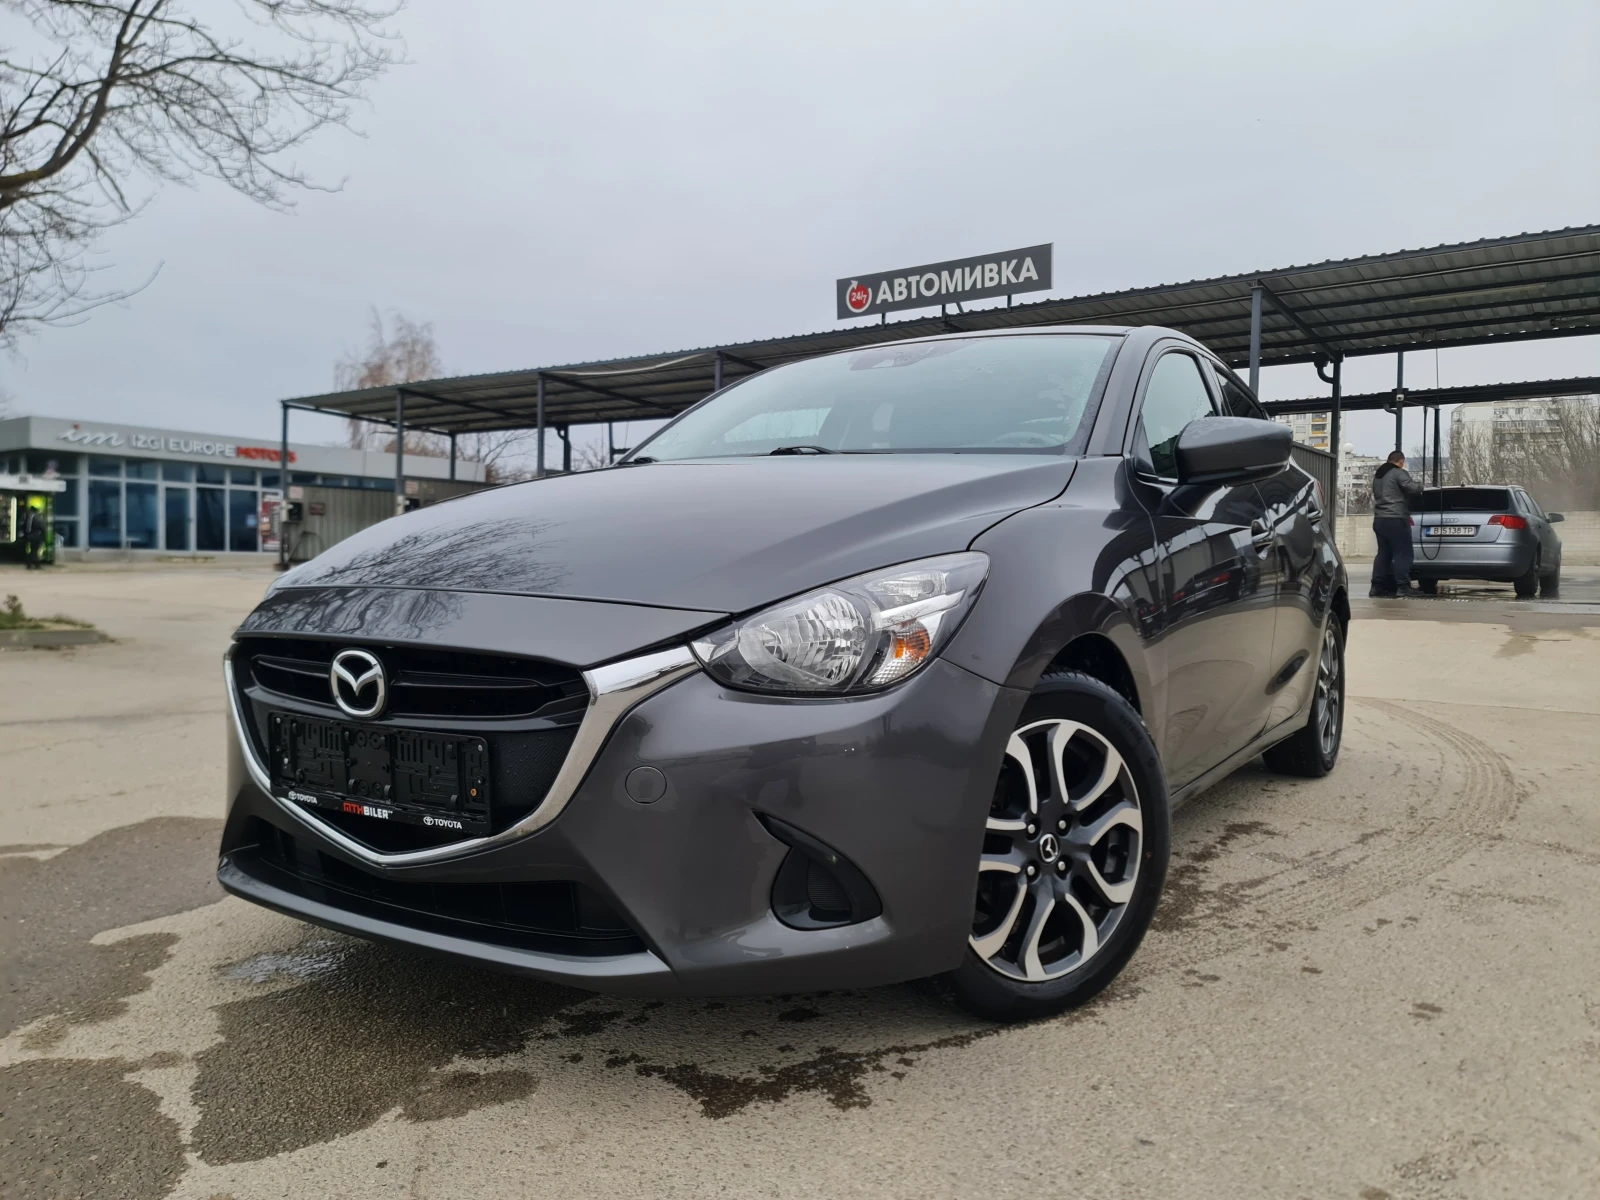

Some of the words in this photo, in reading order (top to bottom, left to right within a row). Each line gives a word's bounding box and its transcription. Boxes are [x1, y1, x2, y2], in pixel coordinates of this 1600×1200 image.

[851, 290, 867, 304] 24/7
[876, 257, 1039, 305] АВТОМИВКА
[131, 433, 165, 450] IZGI
[169, 438, 236, 458] EUROPE
[296, 793, 318, 805] TOYOTA
[434, 818, 463, 830] TOYOTA
